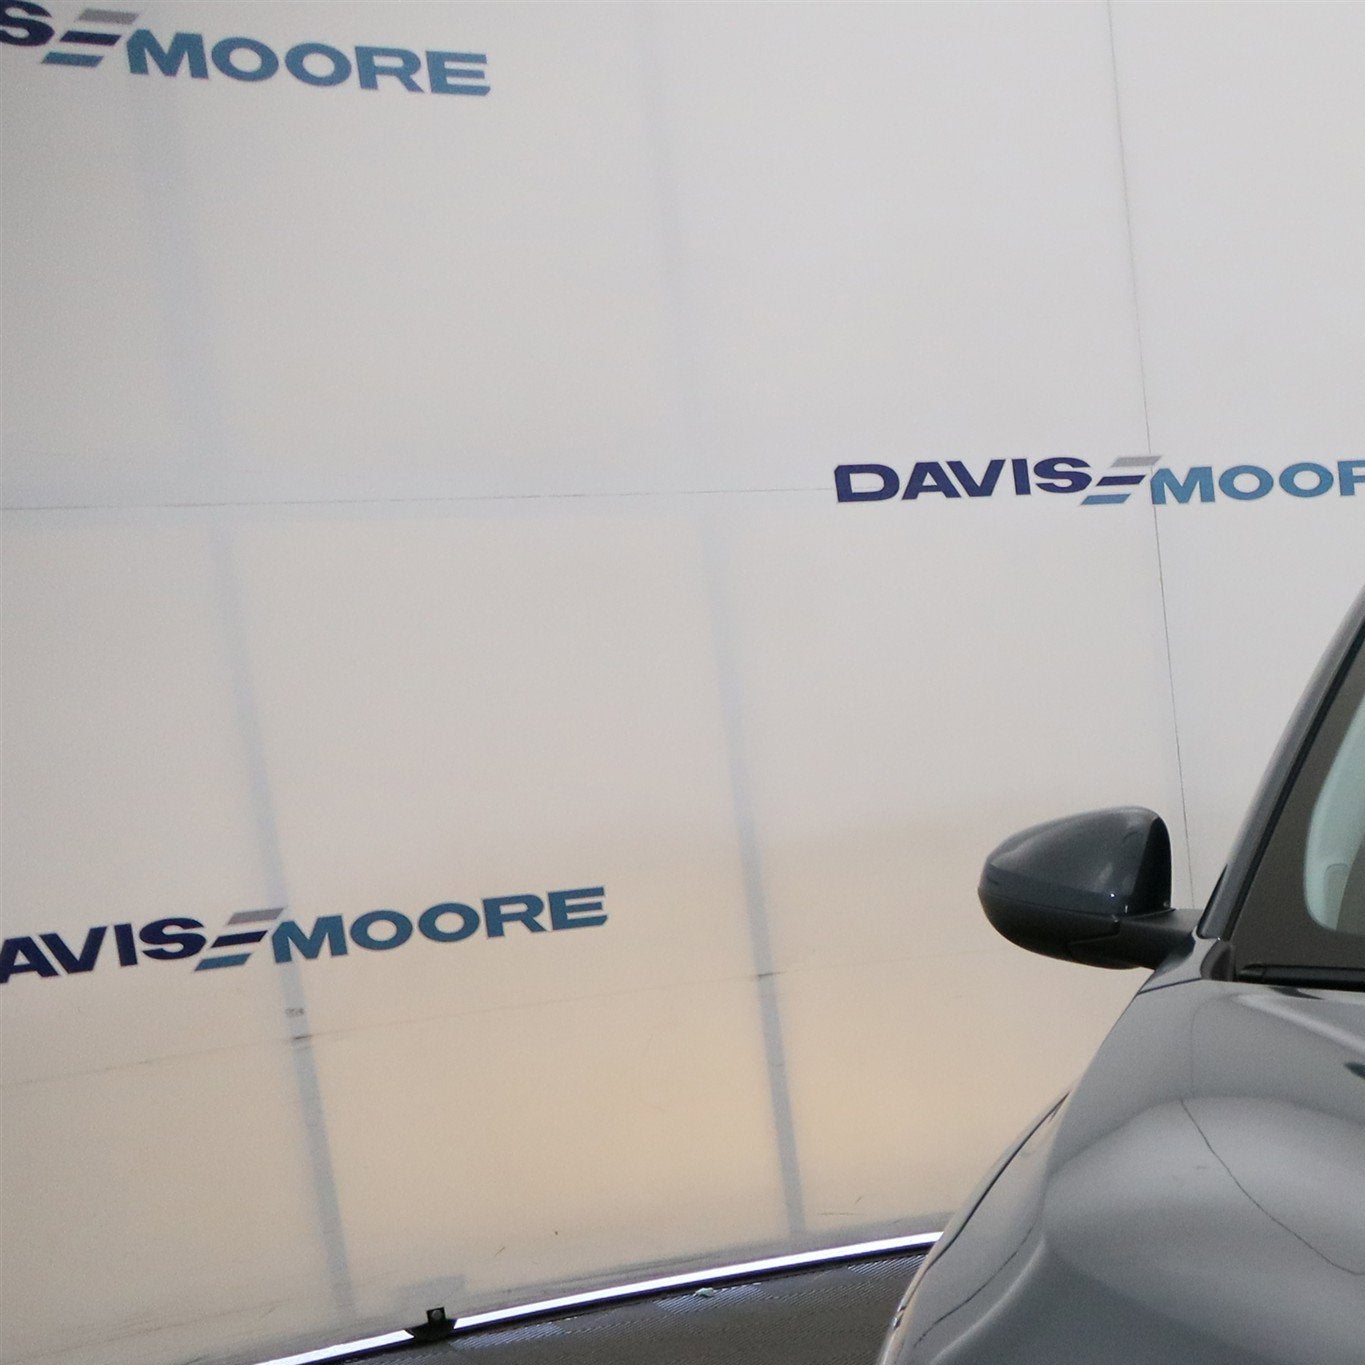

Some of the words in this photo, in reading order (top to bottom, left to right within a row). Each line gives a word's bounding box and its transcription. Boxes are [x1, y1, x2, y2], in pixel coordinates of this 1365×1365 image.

[126, 29, 490, 96] MOORE
[834, 457, 1092, 503] DAVIS
[0, 917, 207, 985] AVIS
[271, 886, 609, 964] MOORE
